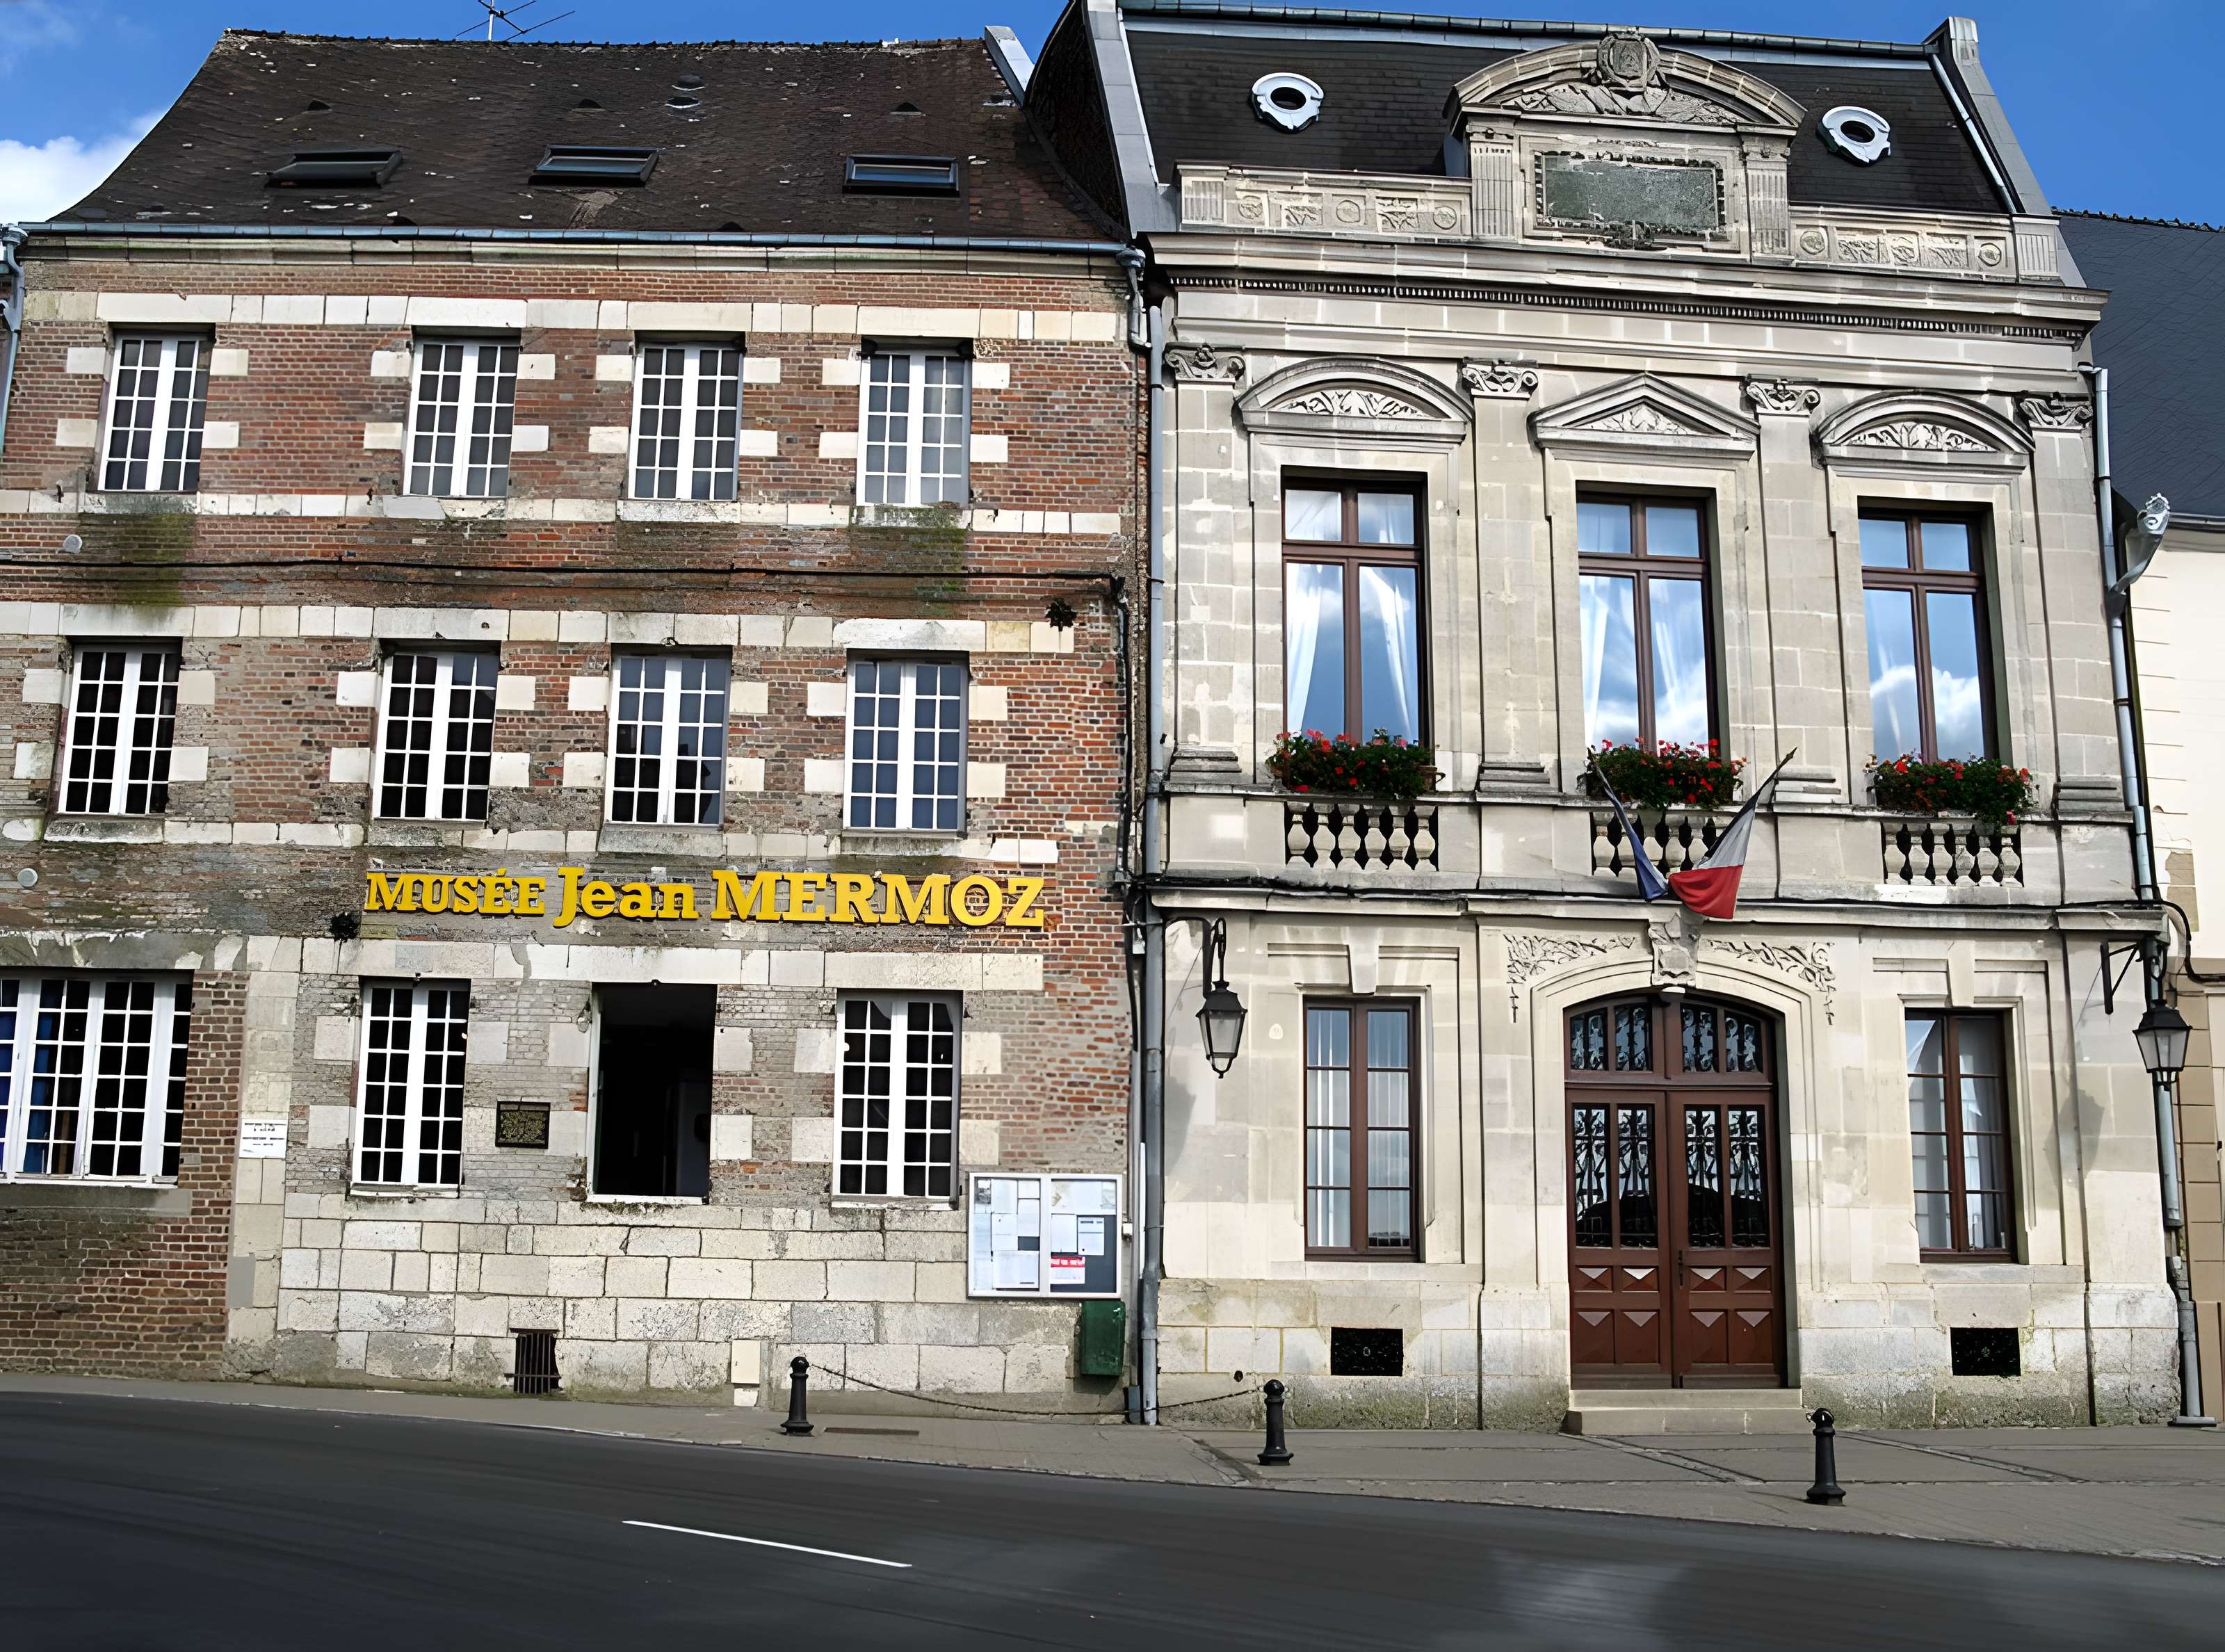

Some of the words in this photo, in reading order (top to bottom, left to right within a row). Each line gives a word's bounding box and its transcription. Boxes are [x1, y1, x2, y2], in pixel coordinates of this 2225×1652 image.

[364, 867, 546, 915] MUSÉE
[553, 866, 700, 928] Jean
[711, 869, 1044, 927] MERMOZ
